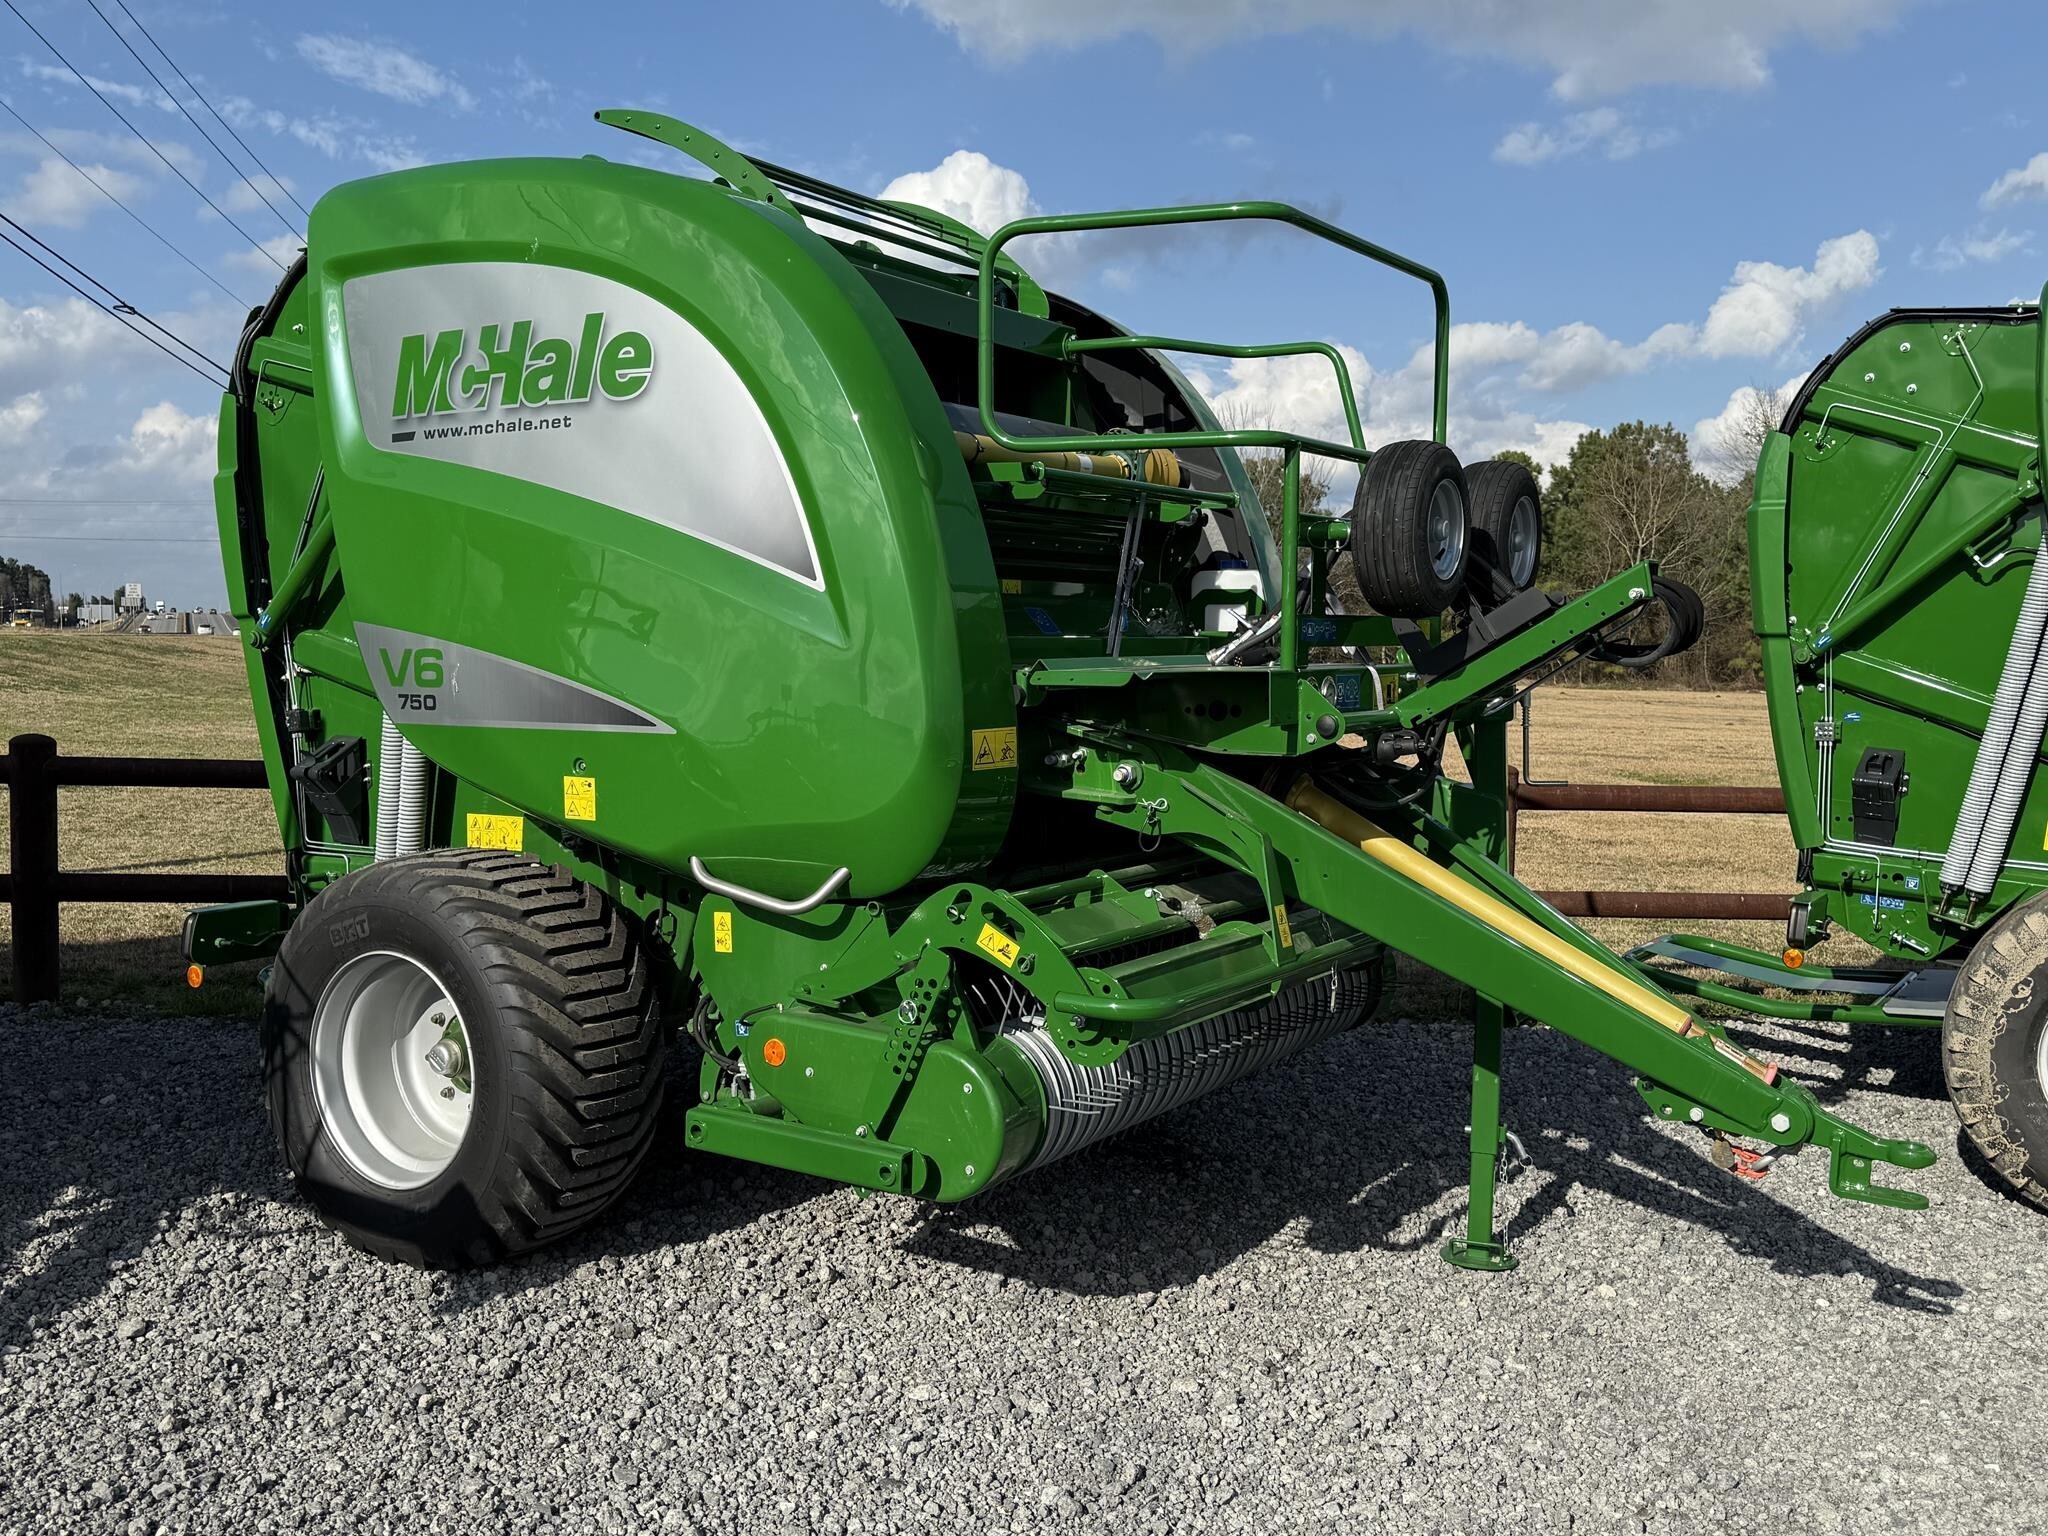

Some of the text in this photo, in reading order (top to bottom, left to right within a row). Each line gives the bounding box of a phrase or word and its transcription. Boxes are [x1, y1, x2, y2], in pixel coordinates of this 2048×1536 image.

[392, 311, 653, 420] McHale
[424, 415, 573, 440] www.mchale.net
[379, 648, 444, 688] V6
[398, 694, 437, 711] 750
